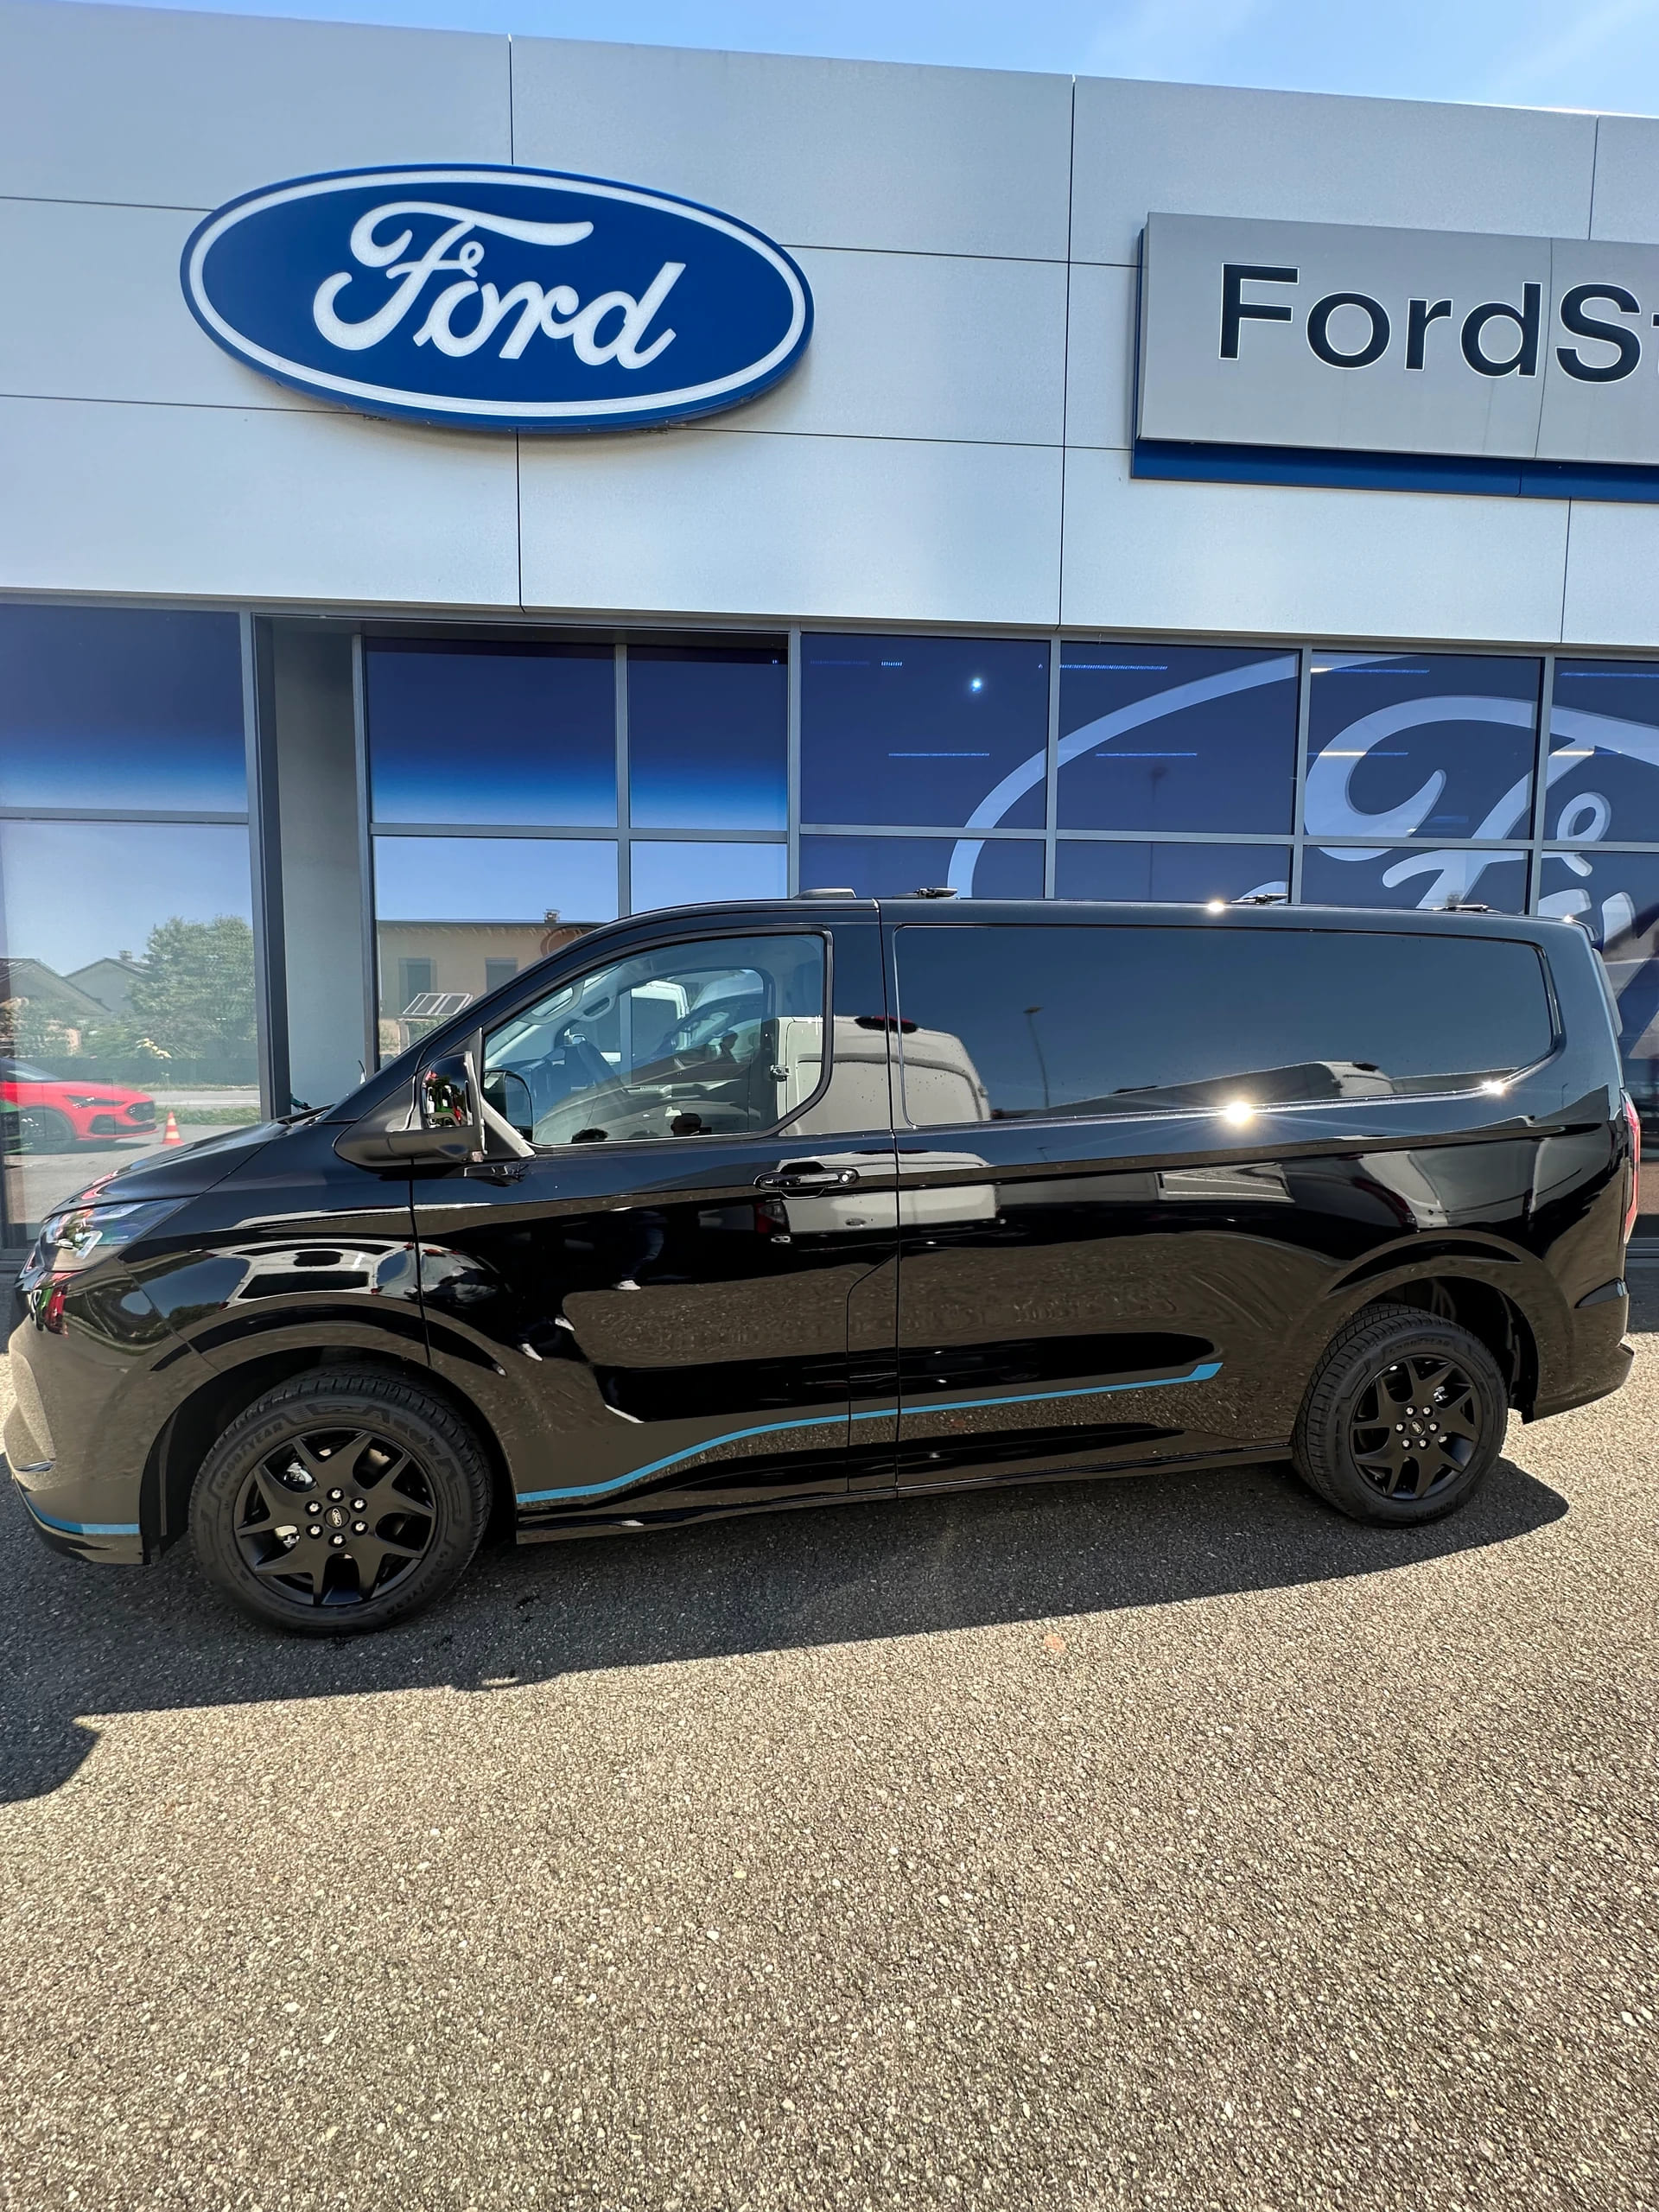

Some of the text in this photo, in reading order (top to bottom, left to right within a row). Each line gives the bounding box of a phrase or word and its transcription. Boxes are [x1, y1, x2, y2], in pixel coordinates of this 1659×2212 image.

[313, 200, 686, 370] Ford
[1217, 262, 1659, 385] FordS
[215, 1421, 284, 1490] GOODYEAR
